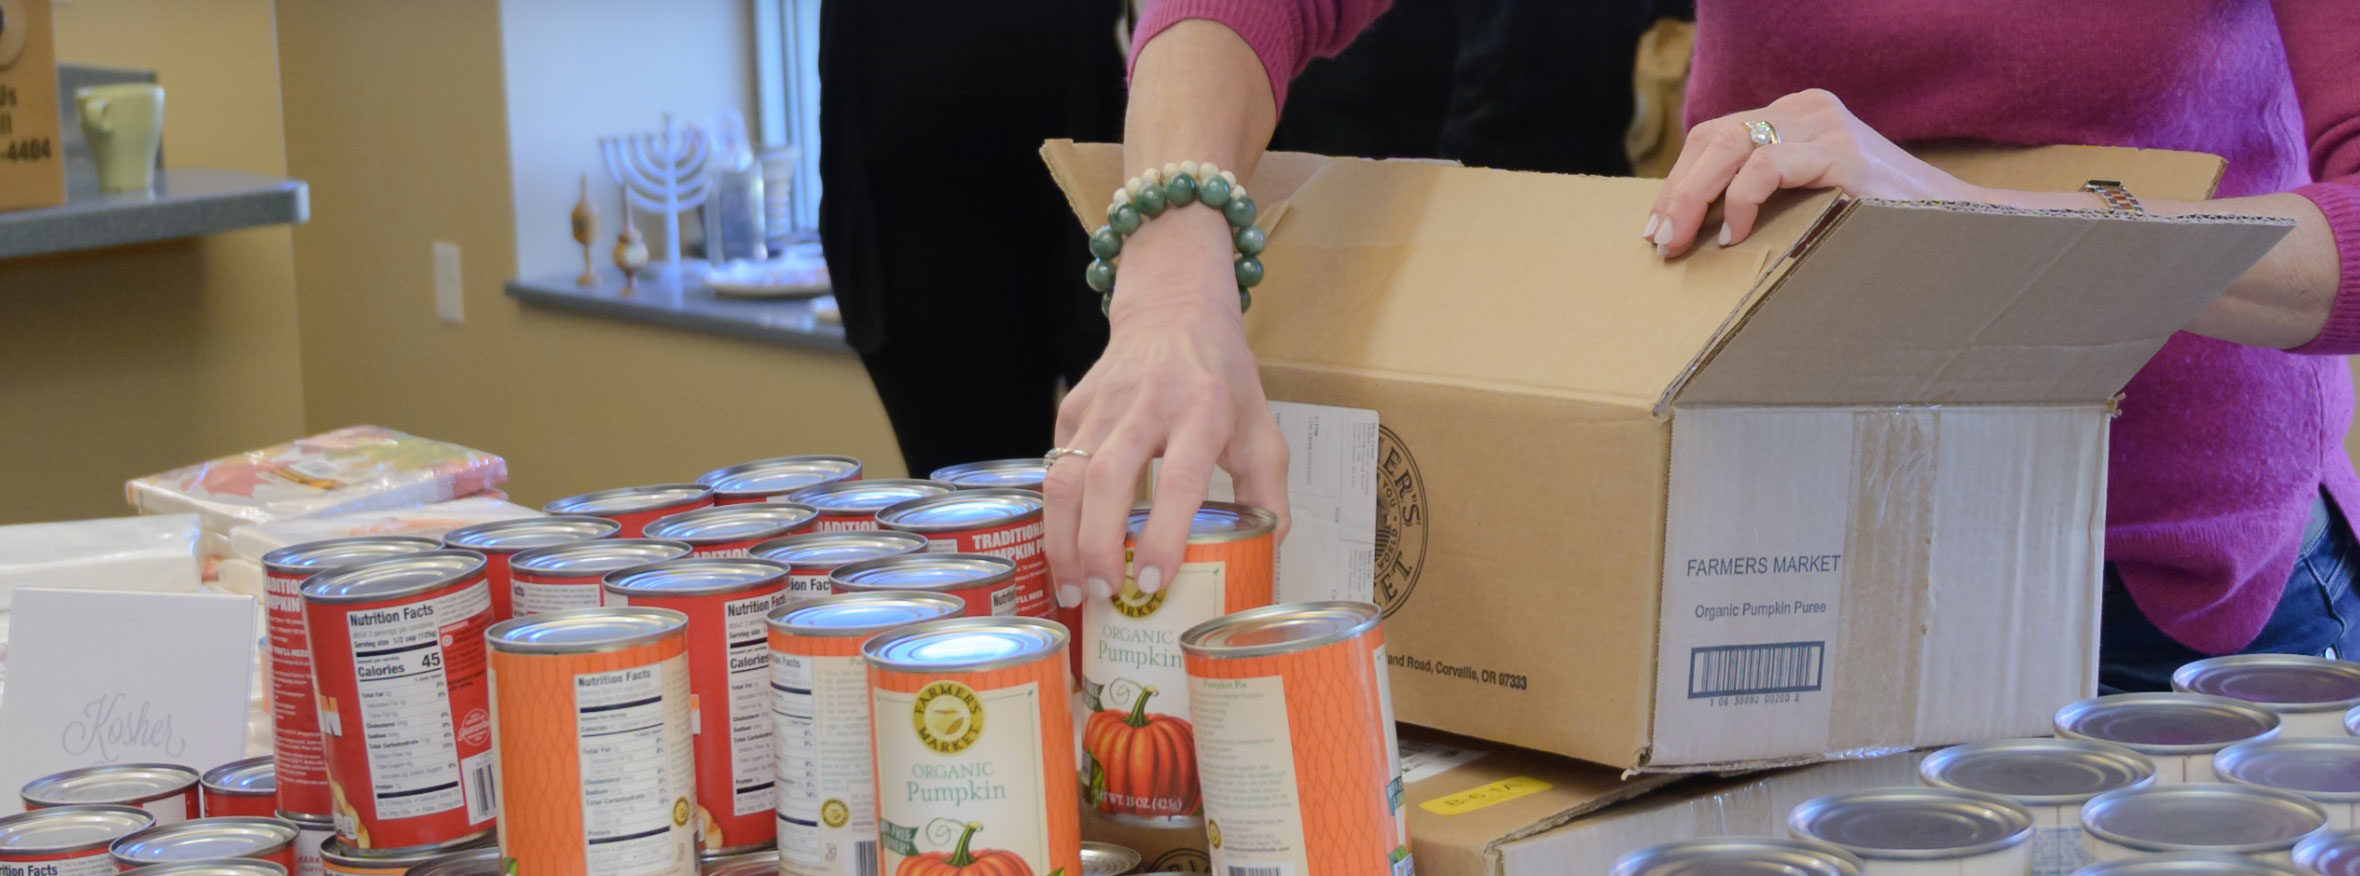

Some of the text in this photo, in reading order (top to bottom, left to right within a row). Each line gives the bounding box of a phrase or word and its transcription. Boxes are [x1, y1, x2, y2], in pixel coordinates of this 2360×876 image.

[1686, 555, 1842, 577] FARMERS MARKET
[350, 610, 400, 627] Nutrition
[403, 603, 434, 621] Facts
[728, 602, 770, 617] Nutrition
[1695, 601, 1827, 621] Organic Pumpkin Puree
[1103, 624, 1173, 645] ORGANIC
[358, 652, 440, 678] Calories 45
[1097, 640, 1182, 669] Pumpkin
[578, 670, 651, 687] Nutrition Facts
[1407, 656, 1434, 674] Road,
[1436, 661, 1480, 683] Corvallis,
[1481, 669, 1497, 685] OR
[1498, 672, 1528, 690] 97333
[62, 693, 186, 762] Kosher
[918, 724, 980, 753] MARKET
[912, 761, 995, 779] ORGANIC
[906, 779, 1007, 807] Pumpkin
[0, 863, 58, 876] rition Facts
